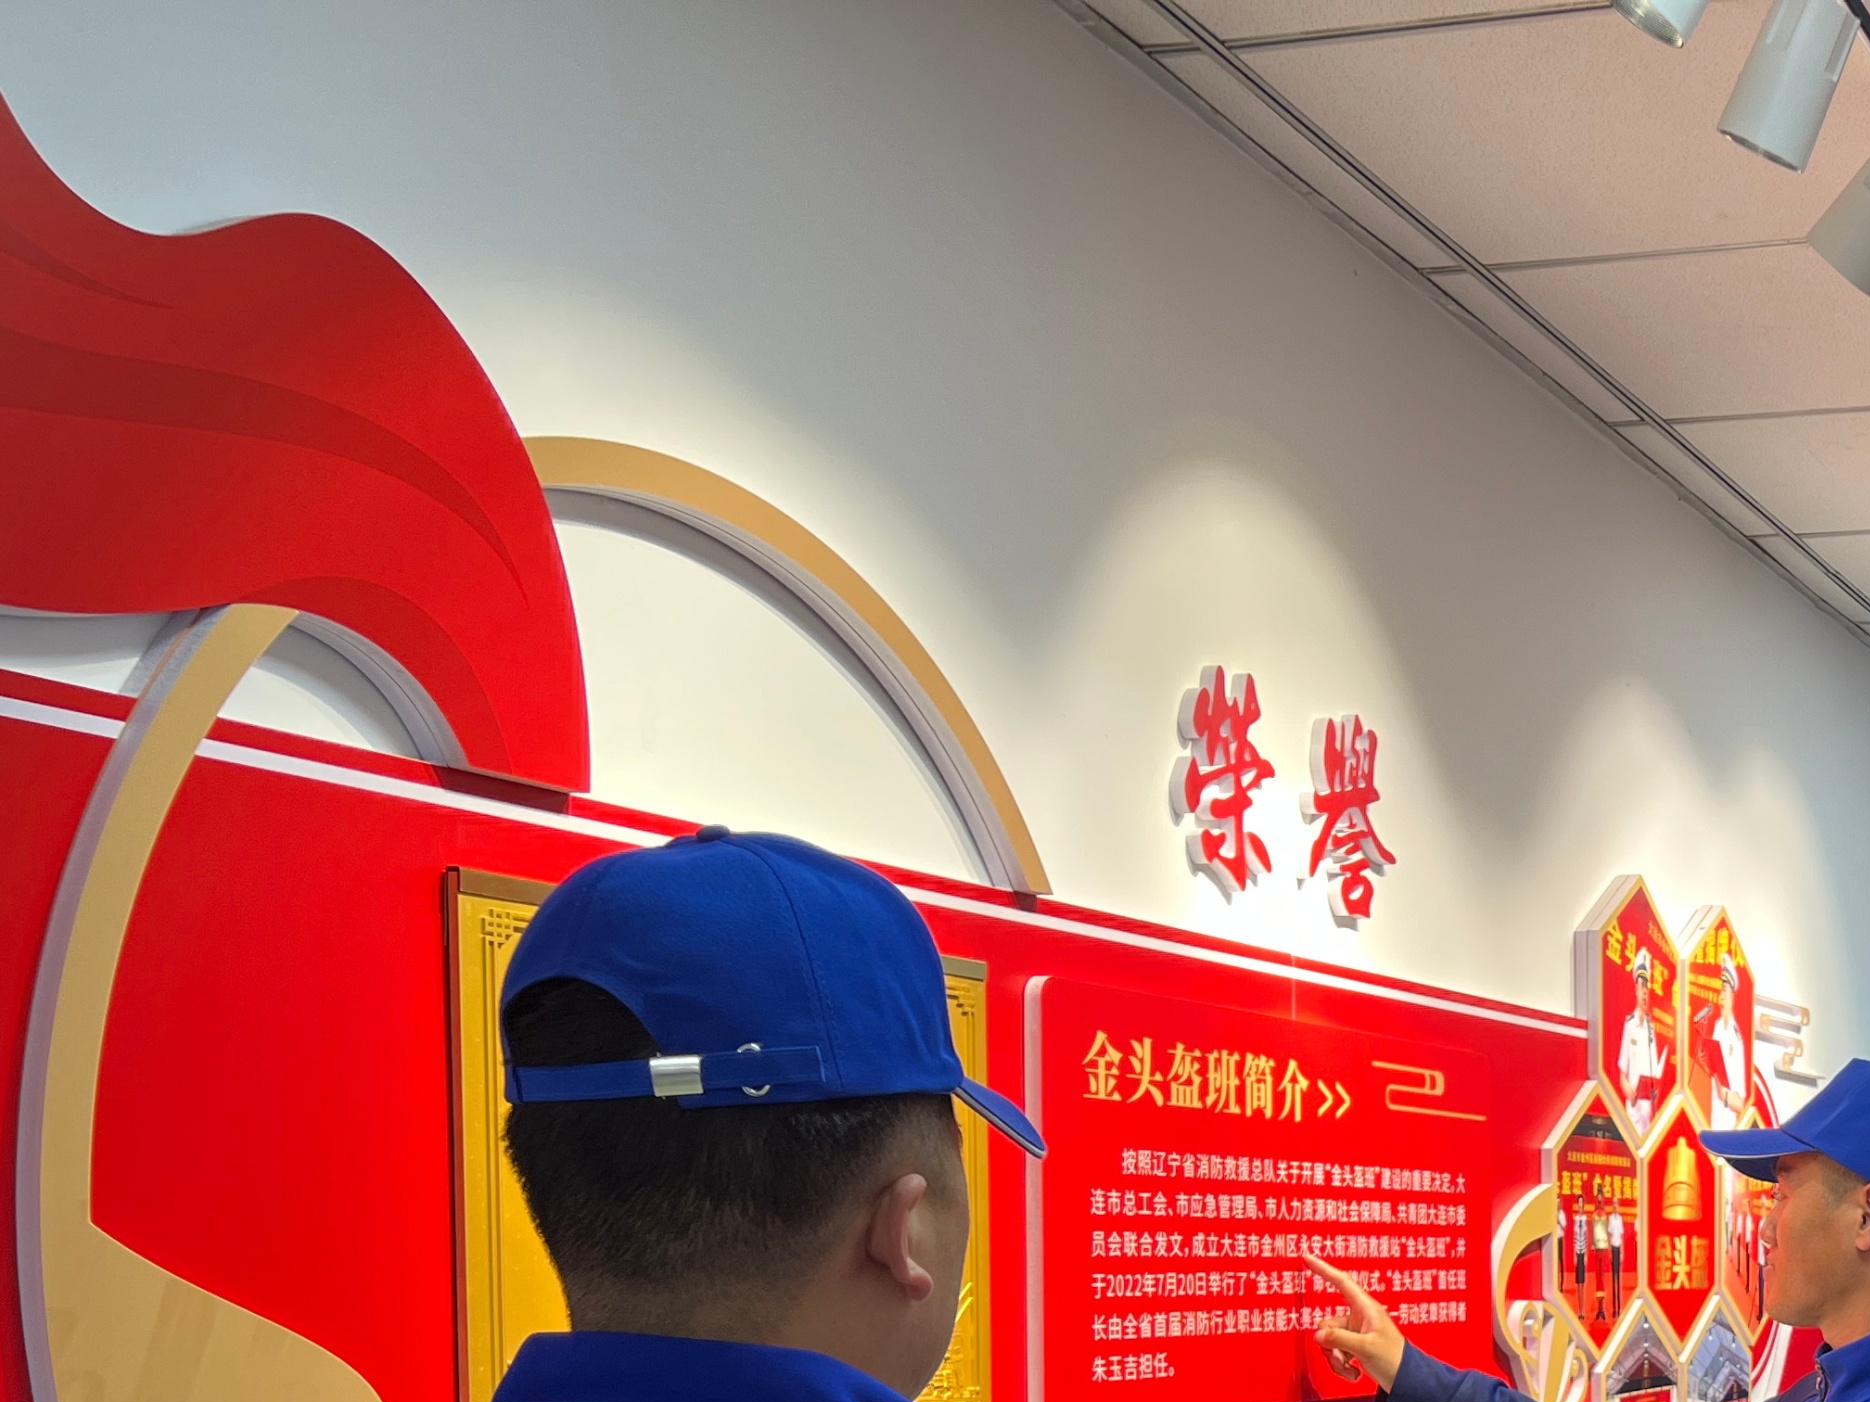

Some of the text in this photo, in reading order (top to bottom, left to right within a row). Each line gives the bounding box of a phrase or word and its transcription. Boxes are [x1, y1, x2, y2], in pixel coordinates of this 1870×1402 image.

[1082, 1030, 1310, 1122] 金头盔班简介
[1092, 1352, 1175, 1383] 朱玉吉担任。
